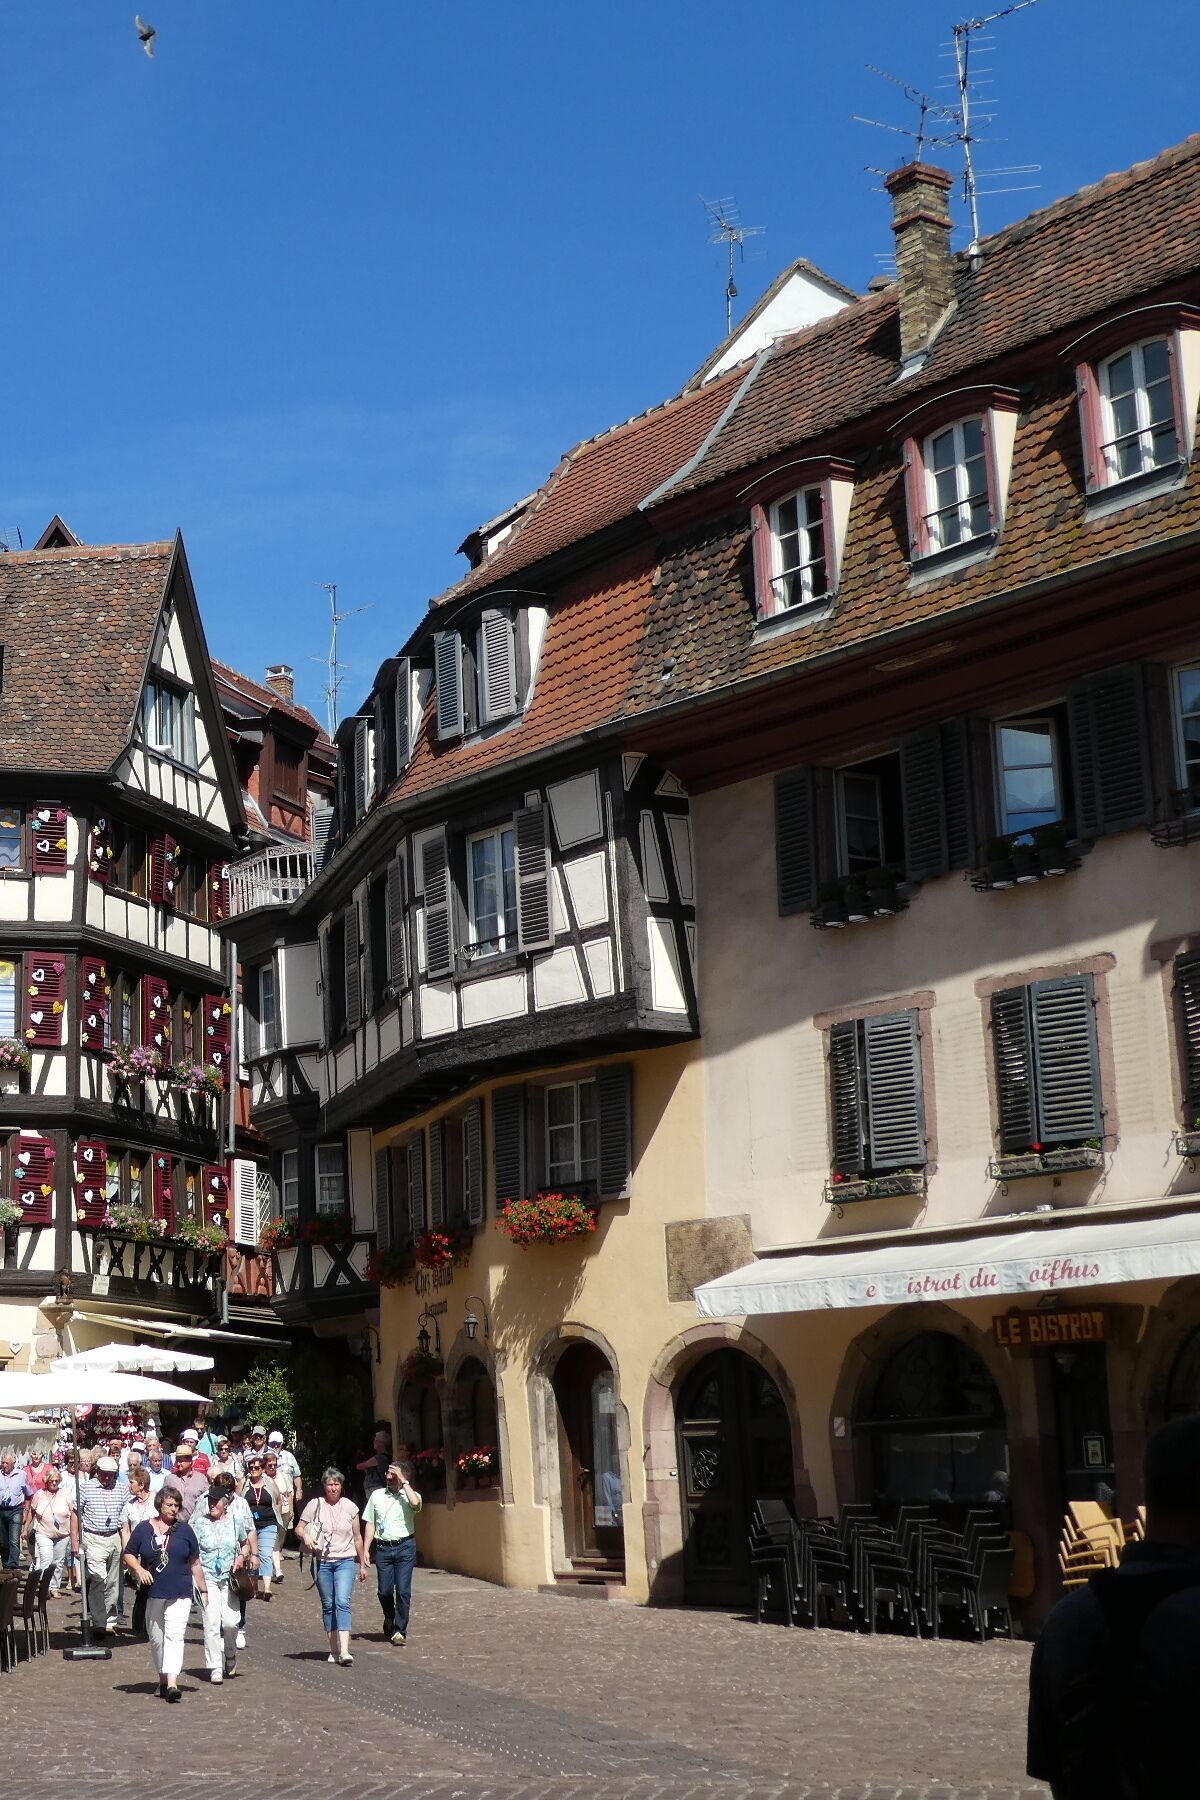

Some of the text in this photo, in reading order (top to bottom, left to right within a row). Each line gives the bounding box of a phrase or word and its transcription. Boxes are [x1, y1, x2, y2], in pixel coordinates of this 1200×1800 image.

[884, 1272, 961, 1297] istrot
[970, 1267, 999, 1289] du
[1006, 1258, 1099, 1288] oïfhus
[996, 1311, 1104, 1344] LE BISTROT
